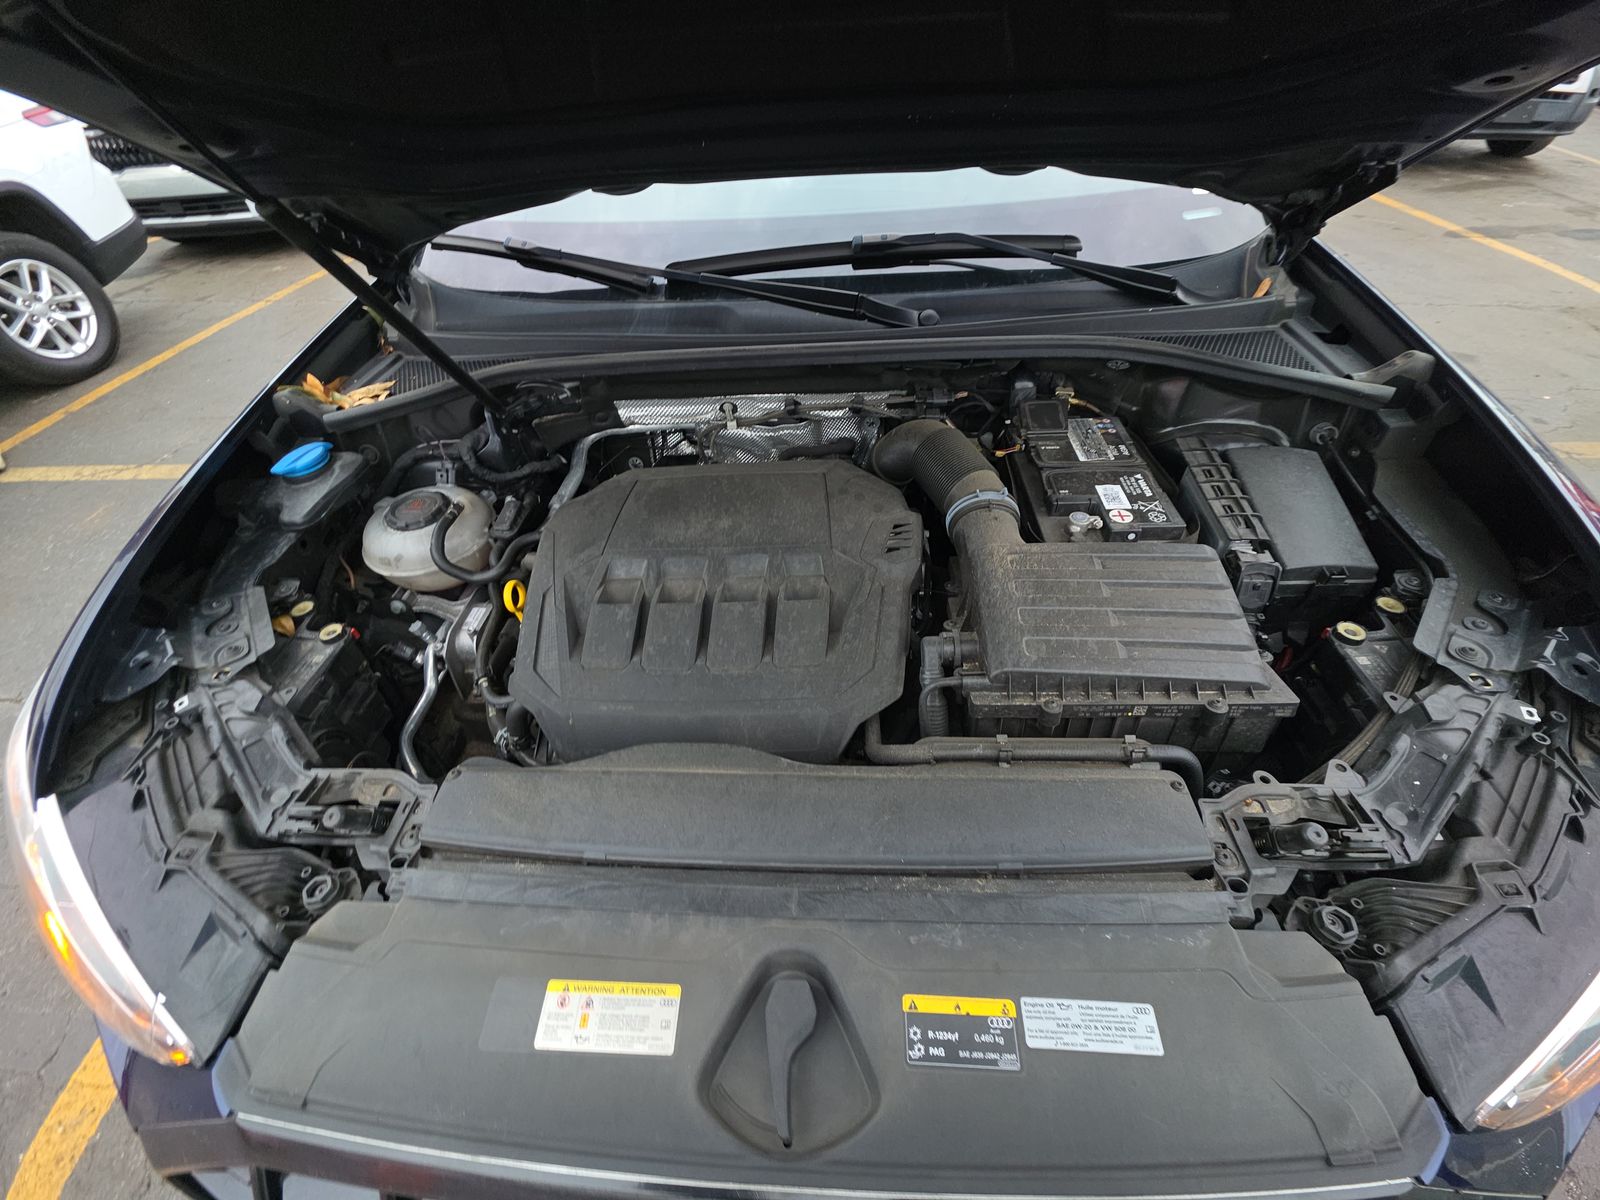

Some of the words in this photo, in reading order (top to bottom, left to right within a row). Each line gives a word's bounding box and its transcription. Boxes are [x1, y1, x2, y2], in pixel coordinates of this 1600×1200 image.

[573, 983, 614, 993] WARNING
[620, 985, 667, 996] ATTENTION
[1023, 1001, 1044, 1009] Engine
[928, 1030, 959, 1043] R-1234yf
[995, 1034, 1005, 1046] kg
[929, 1046, 946, 1057] PAG
